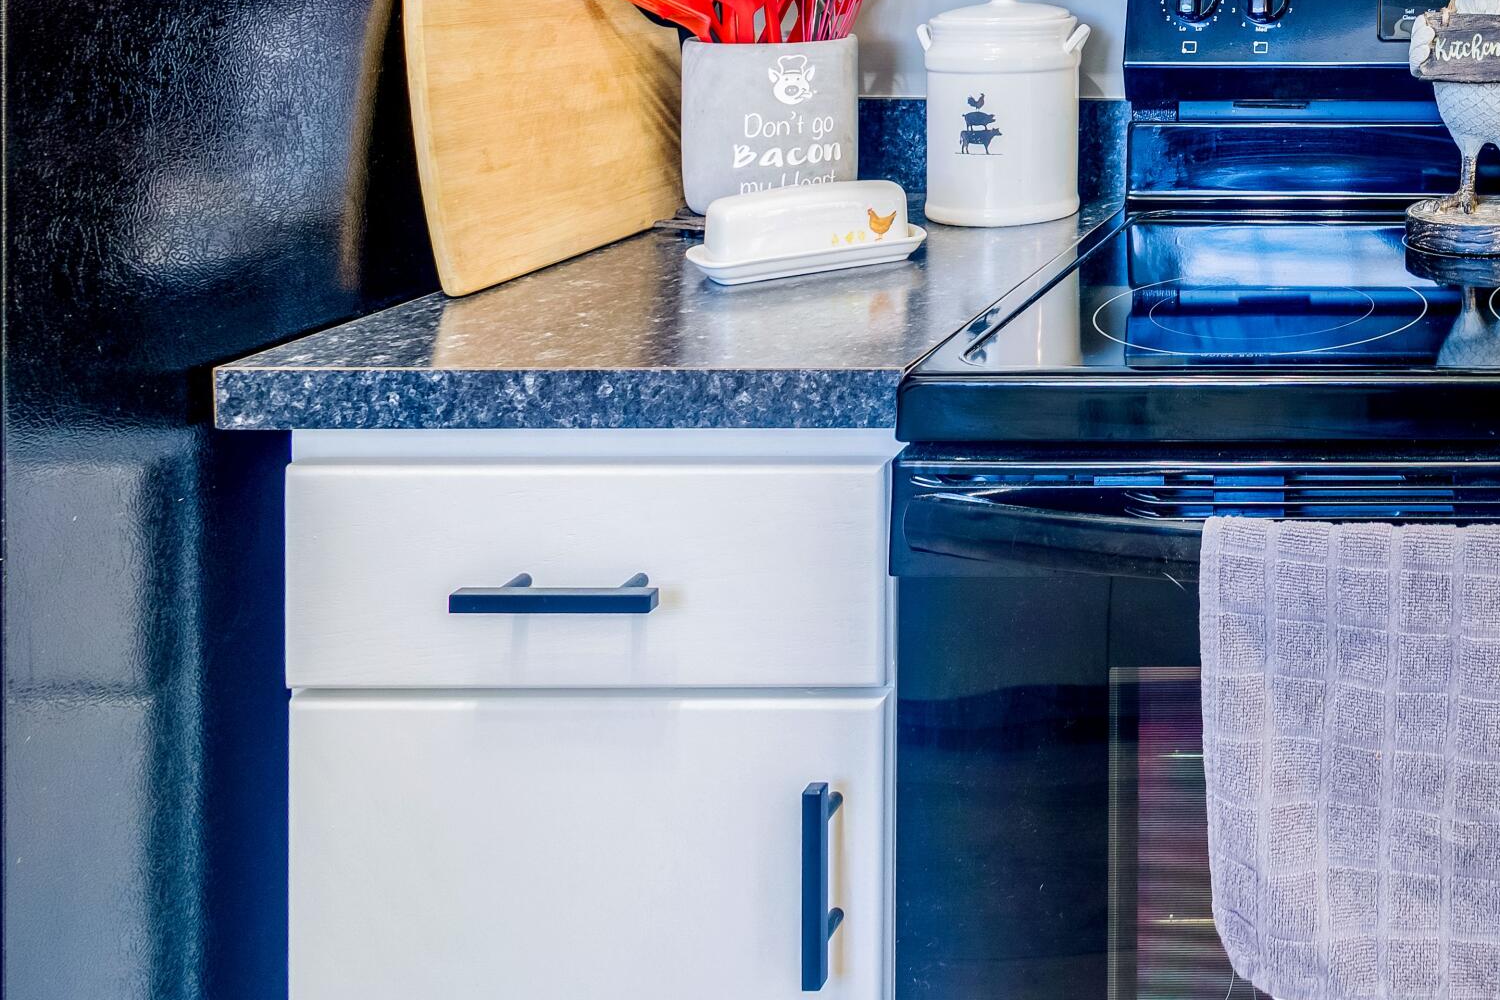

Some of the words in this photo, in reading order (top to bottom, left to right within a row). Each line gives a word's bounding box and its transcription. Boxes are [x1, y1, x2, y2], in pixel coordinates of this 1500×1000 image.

[744, 111, 804, 138] Don't
[812, 115, 834, 140] go
[733, 141, 842, 168] Bacon
